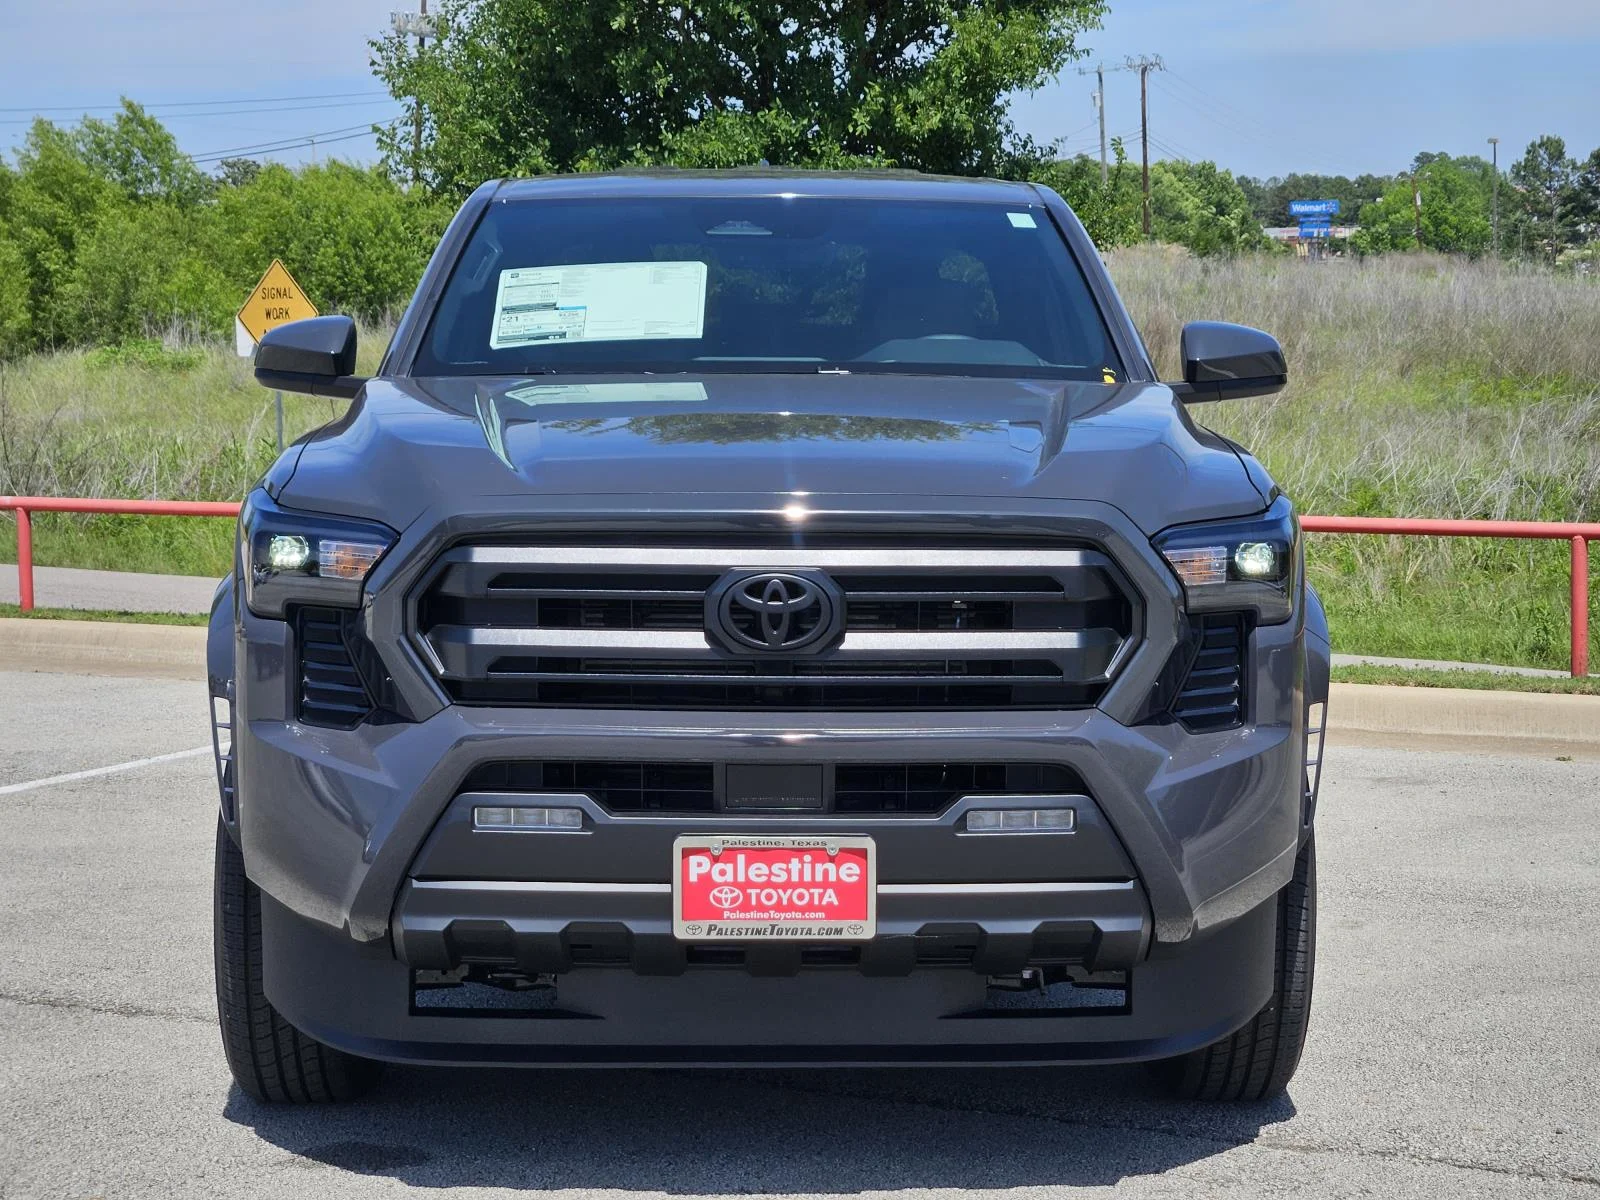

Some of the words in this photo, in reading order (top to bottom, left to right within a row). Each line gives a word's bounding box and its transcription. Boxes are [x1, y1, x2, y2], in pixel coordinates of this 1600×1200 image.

[1292, 203, 1326, 212] Walmart
[261, 287, 293, 299] SIGNAL
[265, 307, 290, 320] WORK
[721, 839, 785, 847] Palestine,
[688, 854, 861, 883] Palestine
[747, 888, 839, 906] TOYOTA
[723, 910, 825, 921] PalestineToyota.com
